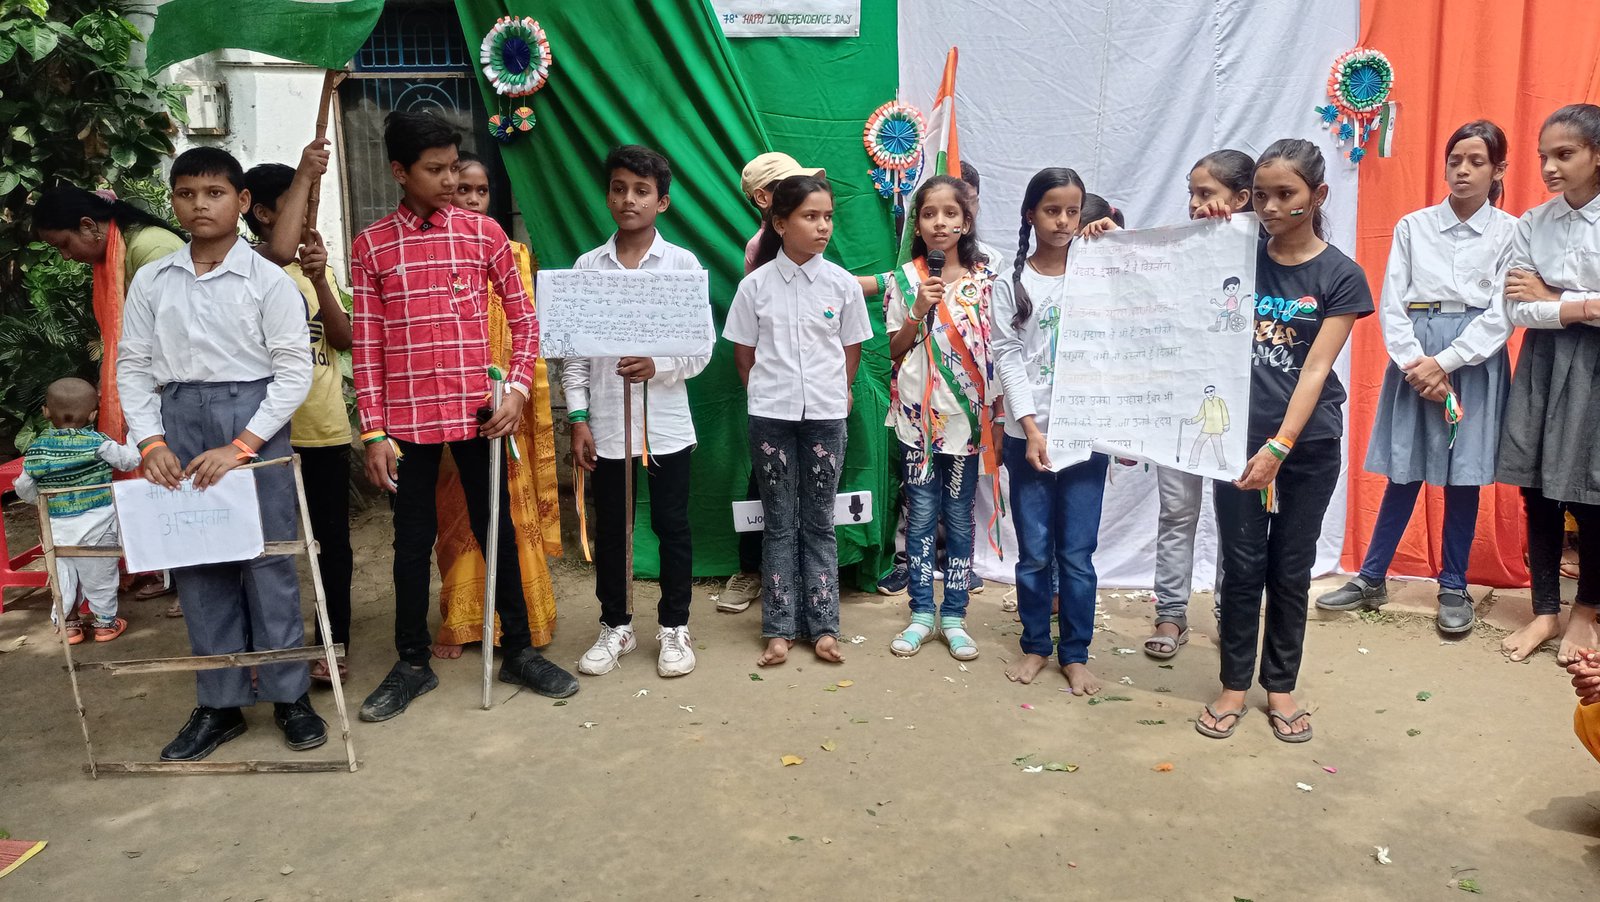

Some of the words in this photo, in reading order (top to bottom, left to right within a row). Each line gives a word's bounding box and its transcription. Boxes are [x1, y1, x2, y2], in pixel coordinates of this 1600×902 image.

[742, 14, 765, 24] HAPPY
[767, 14, 831, 25] INDEPENDENCE
[834, 14, 852, 24] DAY
[920, 536, 934, 558] You
